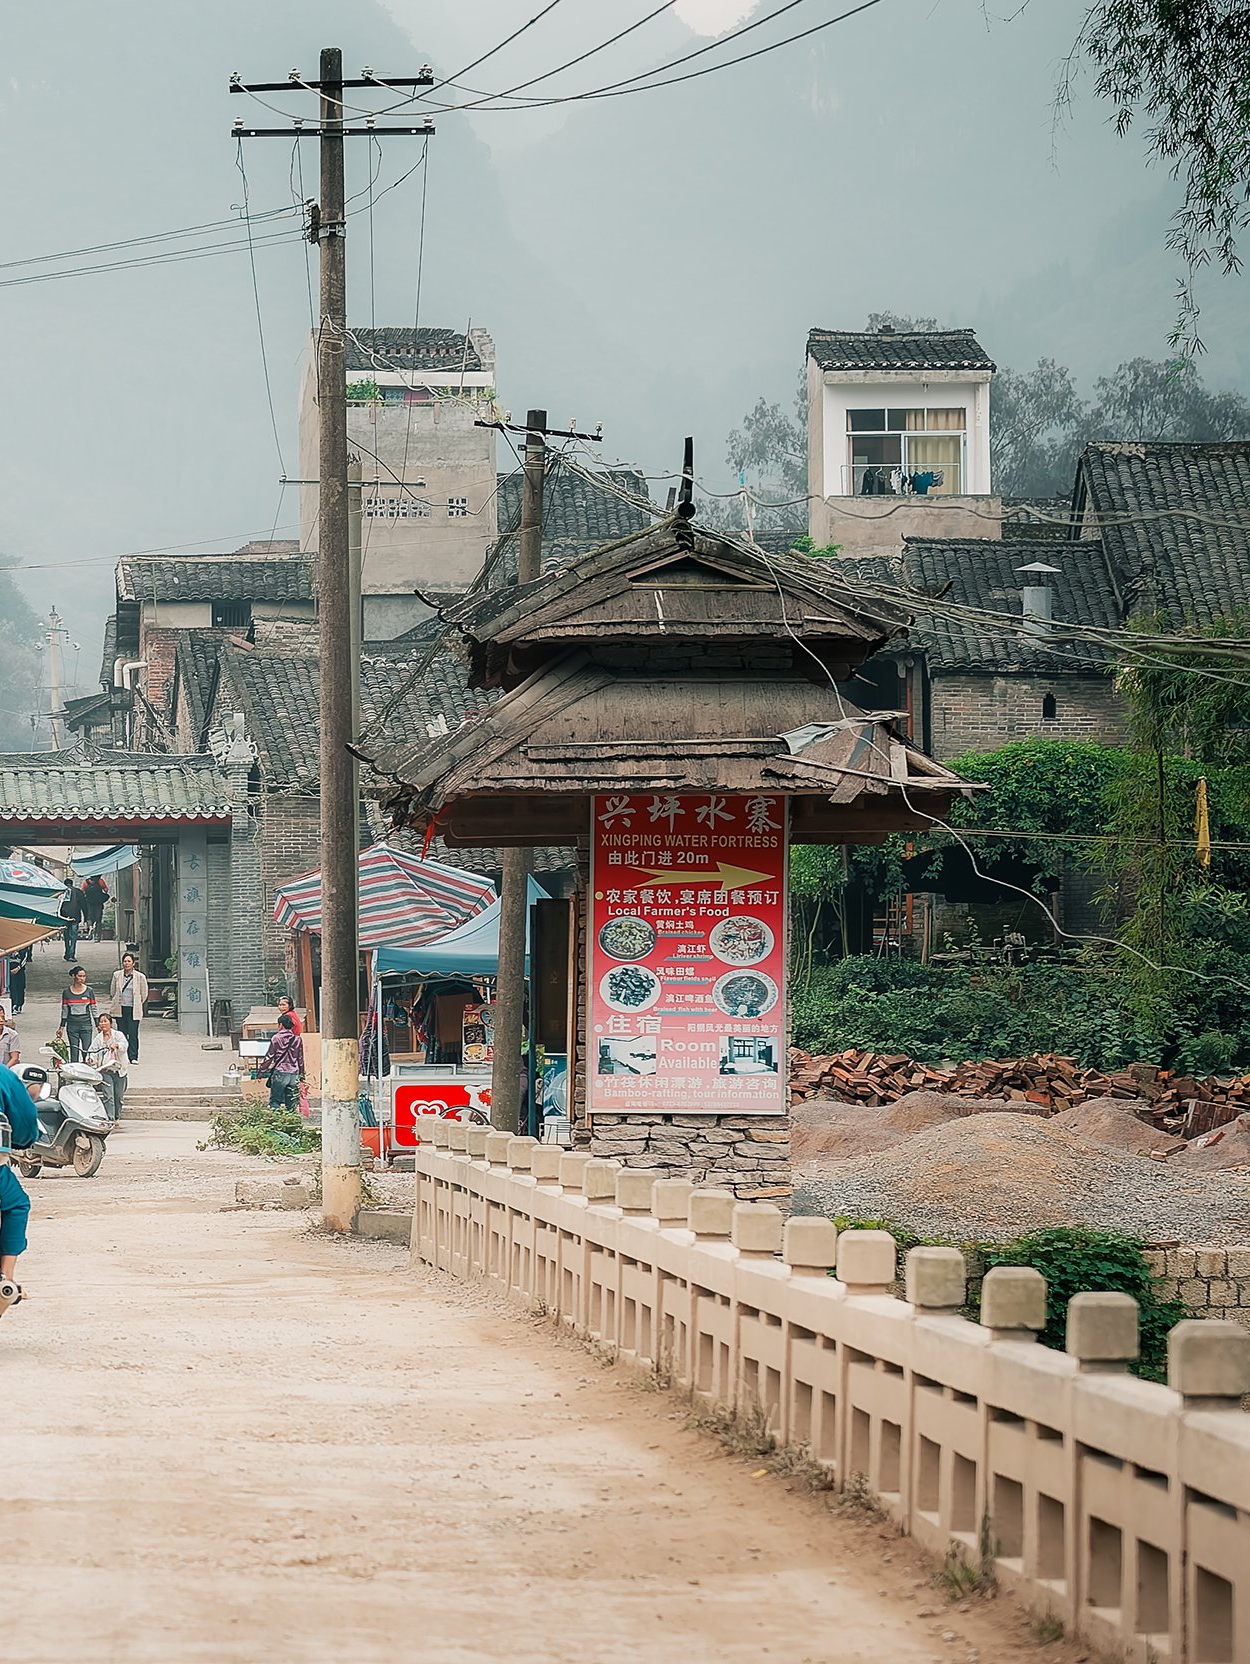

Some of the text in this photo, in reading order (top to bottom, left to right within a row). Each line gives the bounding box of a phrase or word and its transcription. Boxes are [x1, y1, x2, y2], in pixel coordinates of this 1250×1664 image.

[598, 795, 782, 834] 兴坪水寨
[601, 834, 779, 849] XINGPING WATER FORTRESS
[608, 850, 709, 866] 由此门进 20m
[608, 905, 730, 917] Local Farmer's Food
[655, 920, 695, 929] 黄焖土鸡
[677, 944, 707, 954] 漓江虾
[655, 966, 695, 976] 风味田螺
[606, 1014, 662, 1034] 住宿
[661, 1039, 717, 1052] Room
[659, 1056, 717, 1070] Available
[604, 1089, 779, 1100] Bamboo-rafting, tour information
